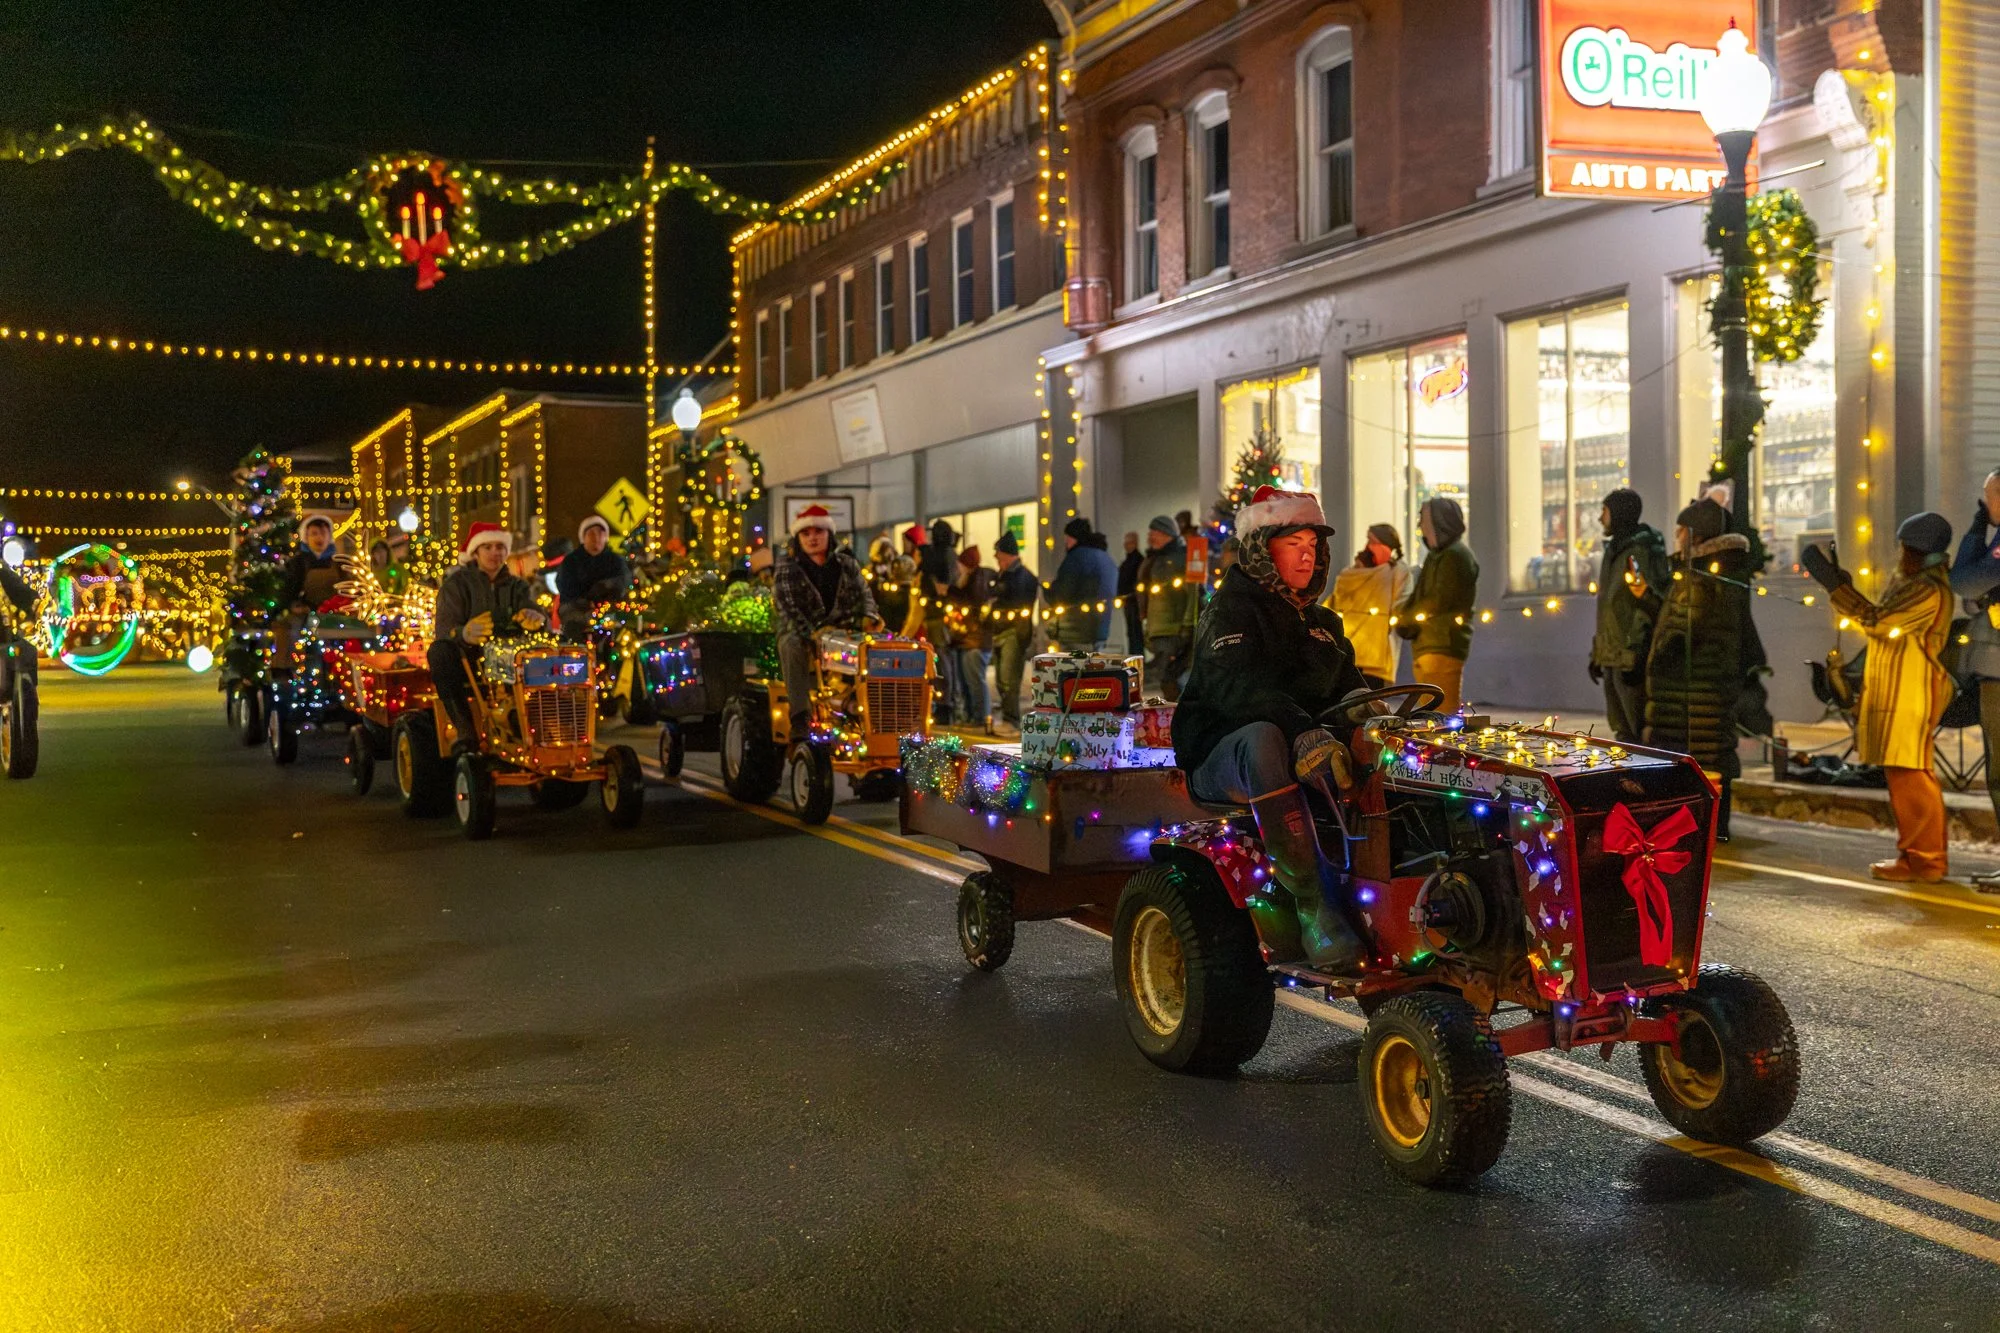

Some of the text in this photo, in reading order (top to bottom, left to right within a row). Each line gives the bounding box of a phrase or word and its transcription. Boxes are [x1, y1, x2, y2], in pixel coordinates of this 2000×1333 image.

[1573, 37, 1709, 101] O'Reil
[1570, 162, 1729, 193] AUTO PART
[1395, 765, 1435, 782] WHEEL
[1440, 772, 1474, 788] HORS
